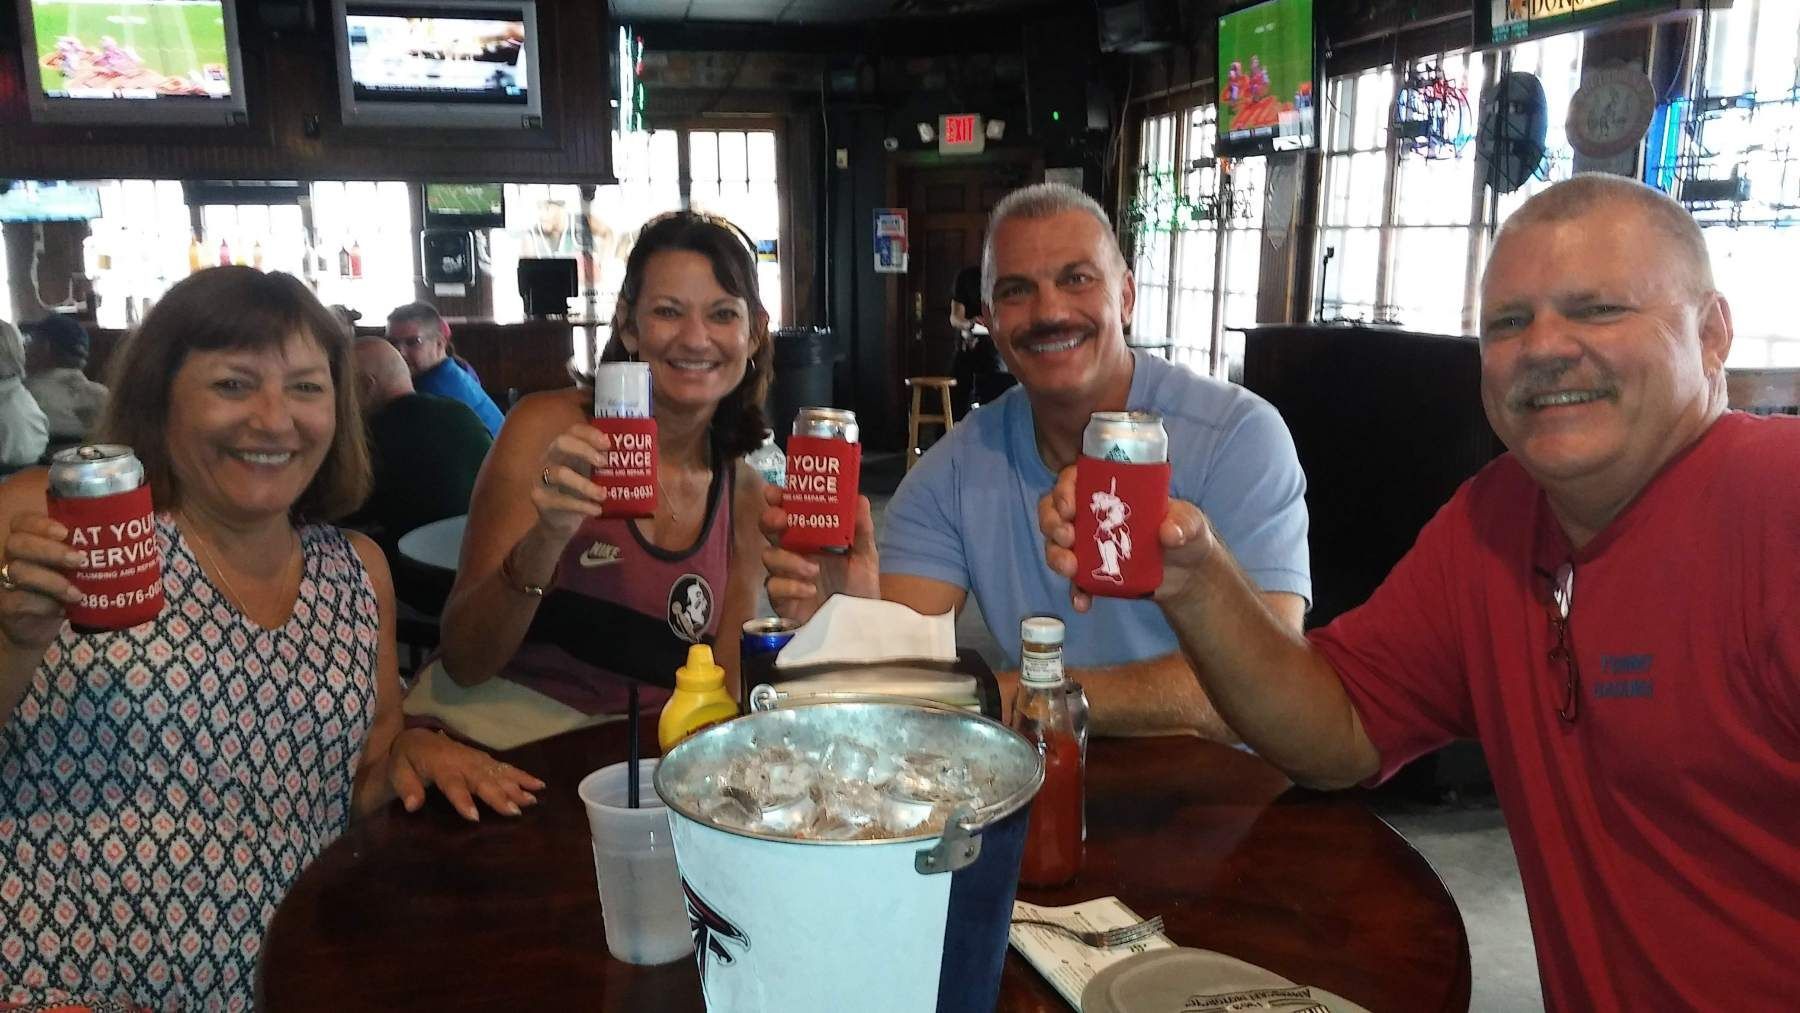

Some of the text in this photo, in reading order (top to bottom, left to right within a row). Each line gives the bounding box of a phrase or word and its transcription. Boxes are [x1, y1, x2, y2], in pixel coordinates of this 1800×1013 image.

[945, 115, 975, 144] EXIT
[612, 432, 652, 451] YOUR
[794, 455, 840, 474] YOUR
[72, 526, 102, 546] AT
[590, 541, 621, 559] NIKE
[120, 567, 136, 577] AND
